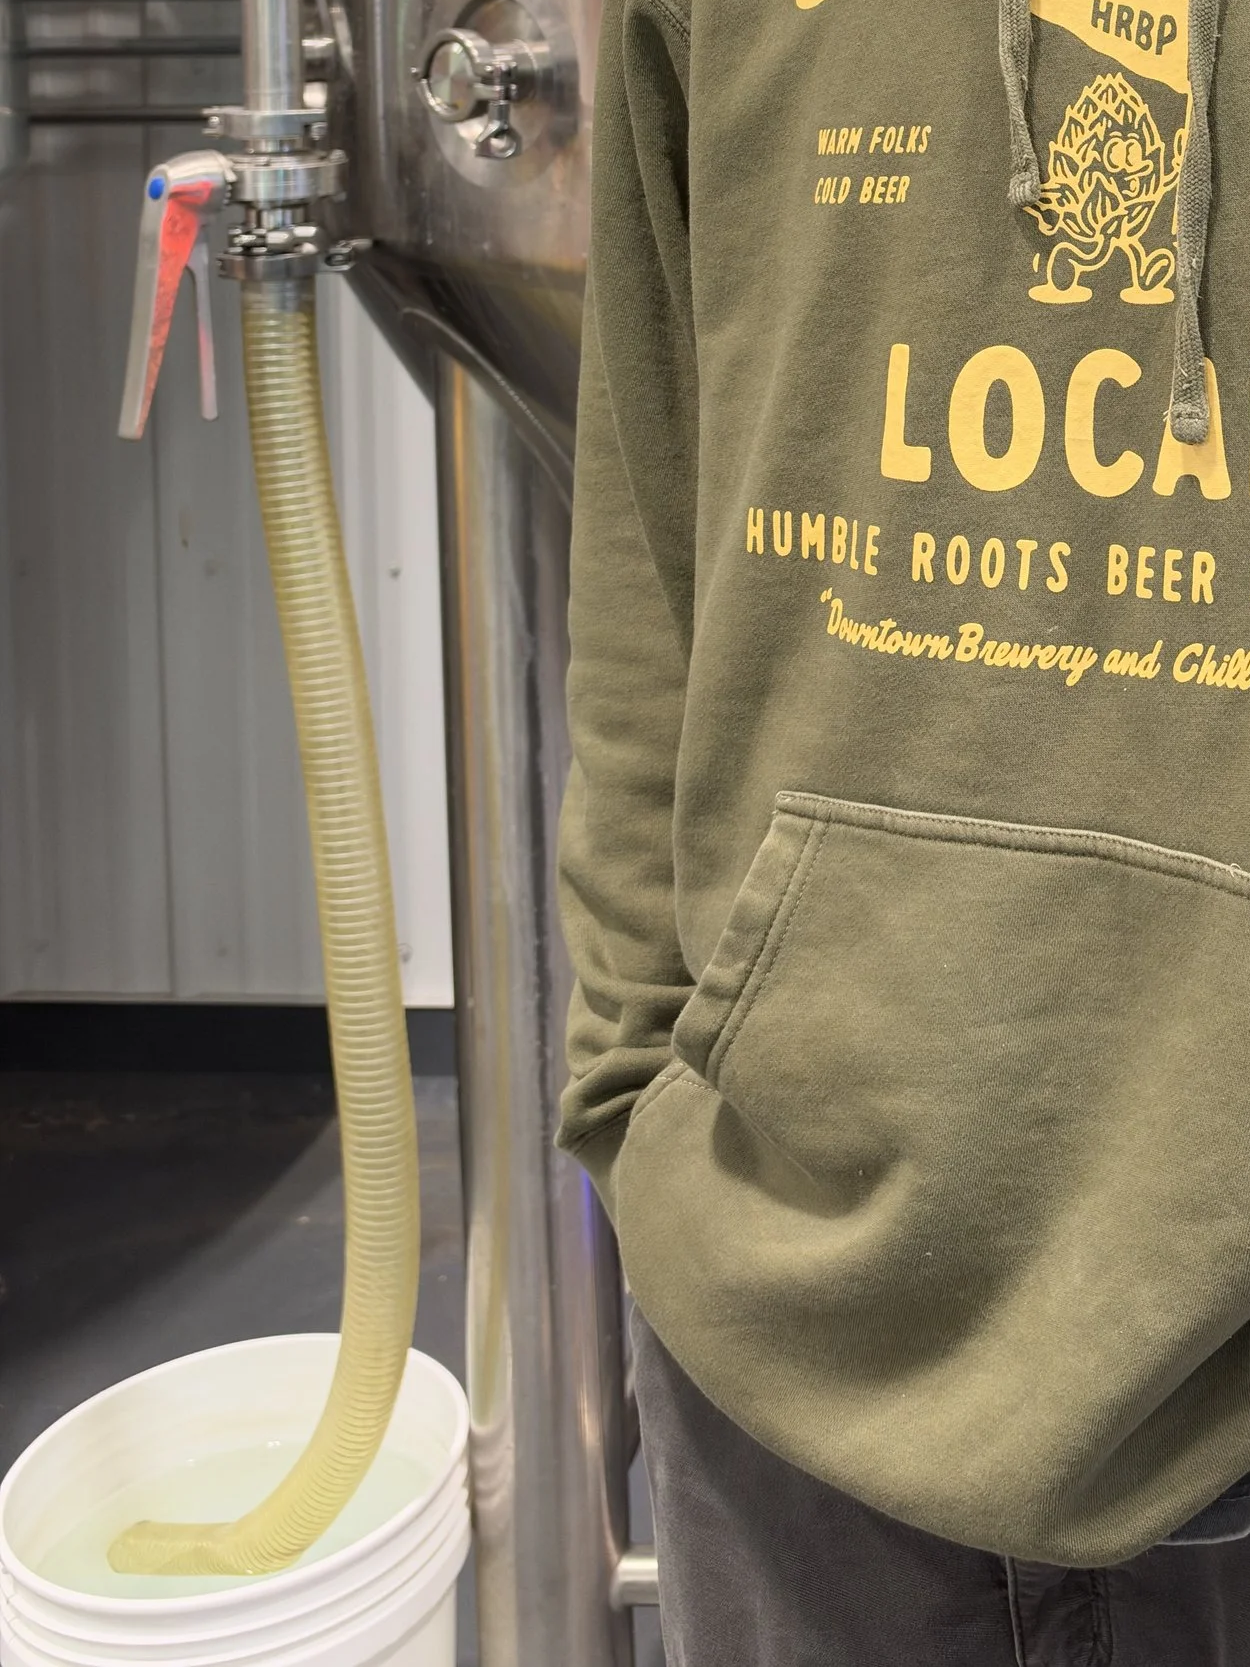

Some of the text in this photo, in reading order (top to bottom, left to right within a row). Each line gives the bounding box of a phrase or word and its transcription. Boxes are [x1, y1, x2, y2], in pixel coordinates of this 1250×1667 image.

[817, 125, 932, 156] WARM FOLKS
[814, 175, 911, 205] COLD BEER
[746, 506, 881, 576] HUMBLE
[911, 531, 1072, 593] ROOTS
[1106, 543, 1216, 604] BEER
[953, 622, 1098, 687] Brewery
[1102, 640, 1163, 680] and
